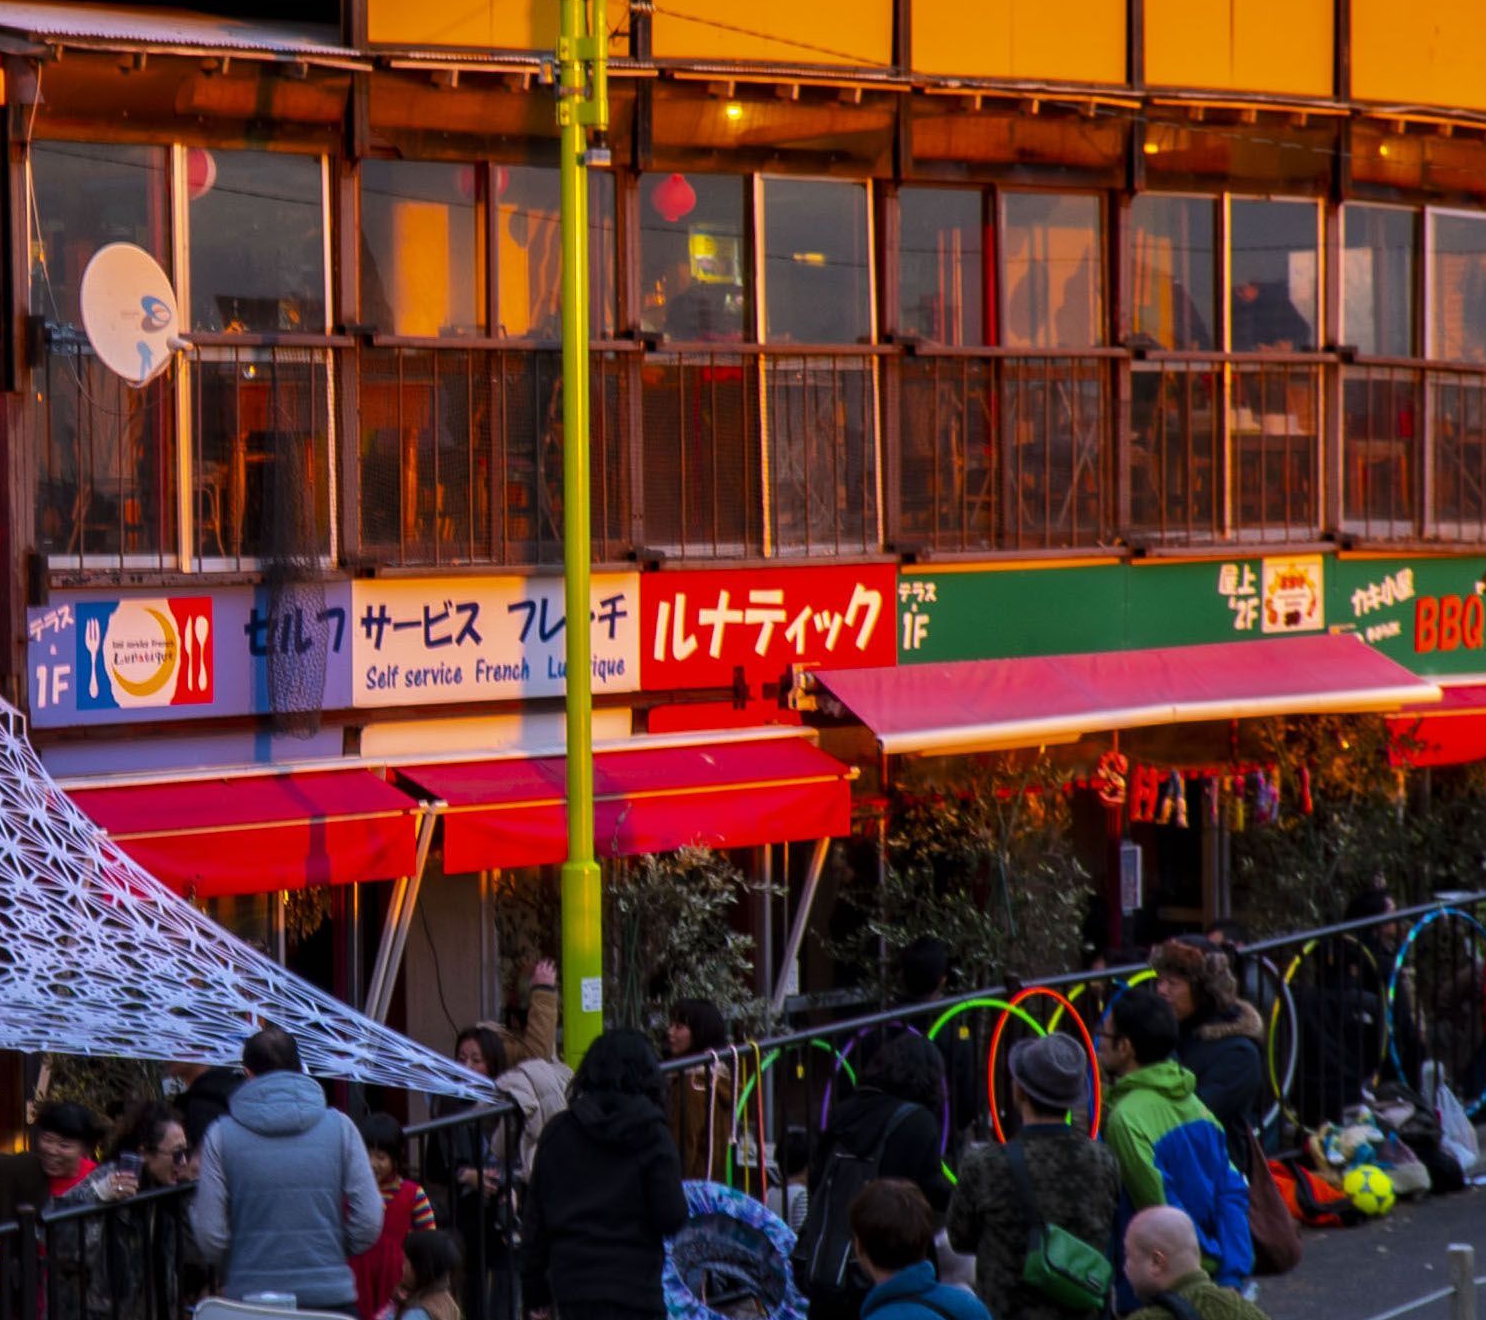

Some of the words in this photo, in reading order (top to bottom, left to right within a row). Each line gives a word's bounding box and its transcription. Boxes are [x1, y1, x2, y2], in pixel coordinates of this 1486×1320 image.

[898, 582, 937, 602] テラス
[29, 604, 75, 642] テラス
[361, 601, 483, 651] サービス
[507, 593, 628, 644] フレチ
[653, 582, 883, 662] ルナティック
[901, 611, 930, 651] 1F
[36, 665, 71, 709] 1F
[366, 665, 399, 689] Self
[405, 662, 463, 687] service
[475, 658, 530, 682] French
[547, 655, 626, 684] Luique
